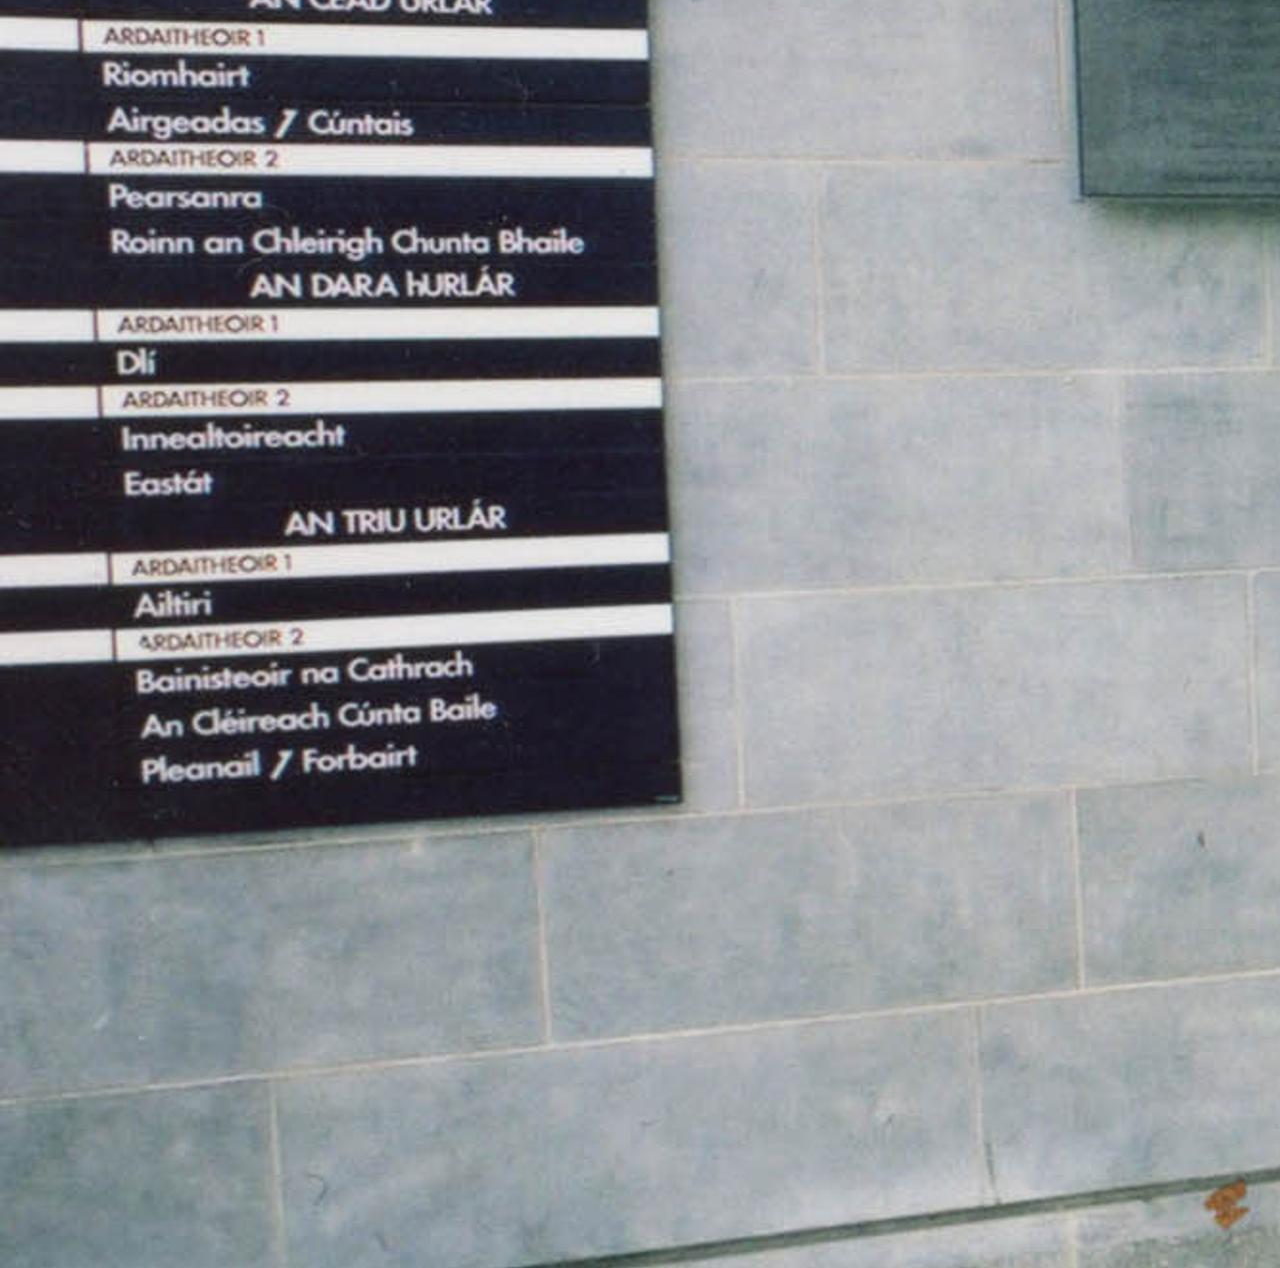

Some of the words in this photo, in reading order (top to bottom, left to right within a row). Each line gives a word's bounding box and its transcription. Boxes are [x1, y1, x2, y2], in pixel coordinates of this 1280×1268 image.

[103, 27, 251, 47] ARDAITHEOIR
[256, 28, 265, 46] 1
[103, 59, 250, 88] Riomhairt
[107, 106, 266, 141] Airgeadas
[307, 109, 414, 136] Cúntais
[109, 148, 256, 169] ARDAITHEOIR
[265, 149, 279, 168] 2
[109, 183, 263, 209] Pearsanra
[111, 229, 195, 254] Roinn
[203, 236, 244, 254] an
[252, 226, 384, 262] Chleirigh
[391, 228, 490, 255] Chunta
[498, 227, 585, 254] Bhaile
[250, 273, 302, 298] AN
[311, 273, 399, 298] DARA
[406, 266, 515, 297] hURLÁR
[117, 314, 264, 334] ARDAITHEOIR
[270, 314, 279, 332] 1
[122, 389, 268, 409] ARDAITHEOIR
[276, 388, 290, 407] 2
[121, 421, 345, 451] Innealtoireacht
[124, 470, 213, 496] Eastát
[284, 511, 334, 536] AN
[342, 508, 406, 534] TRIU
[414, 498, 507, 533] URLÁR
[131, 554, 279, 578] ARDAITHEOIR
[283, 553, 292, 570] 1
[290, 627, 304, 646] 2
[136, 662, 292, 694] Bainisteoir
[301, 666, 339, 684] na
[347, 650, 474, 682] Cathrach
[141, 713, 184, 739] An
[191, 702, 330, 736] Cléireach
[337, 702, 421, 728] Cúnta
[429, 695, 497, 722] Baile
[141, 750, 261, 783] Pleanail
[302, 743, 417, 773] Forbairt
